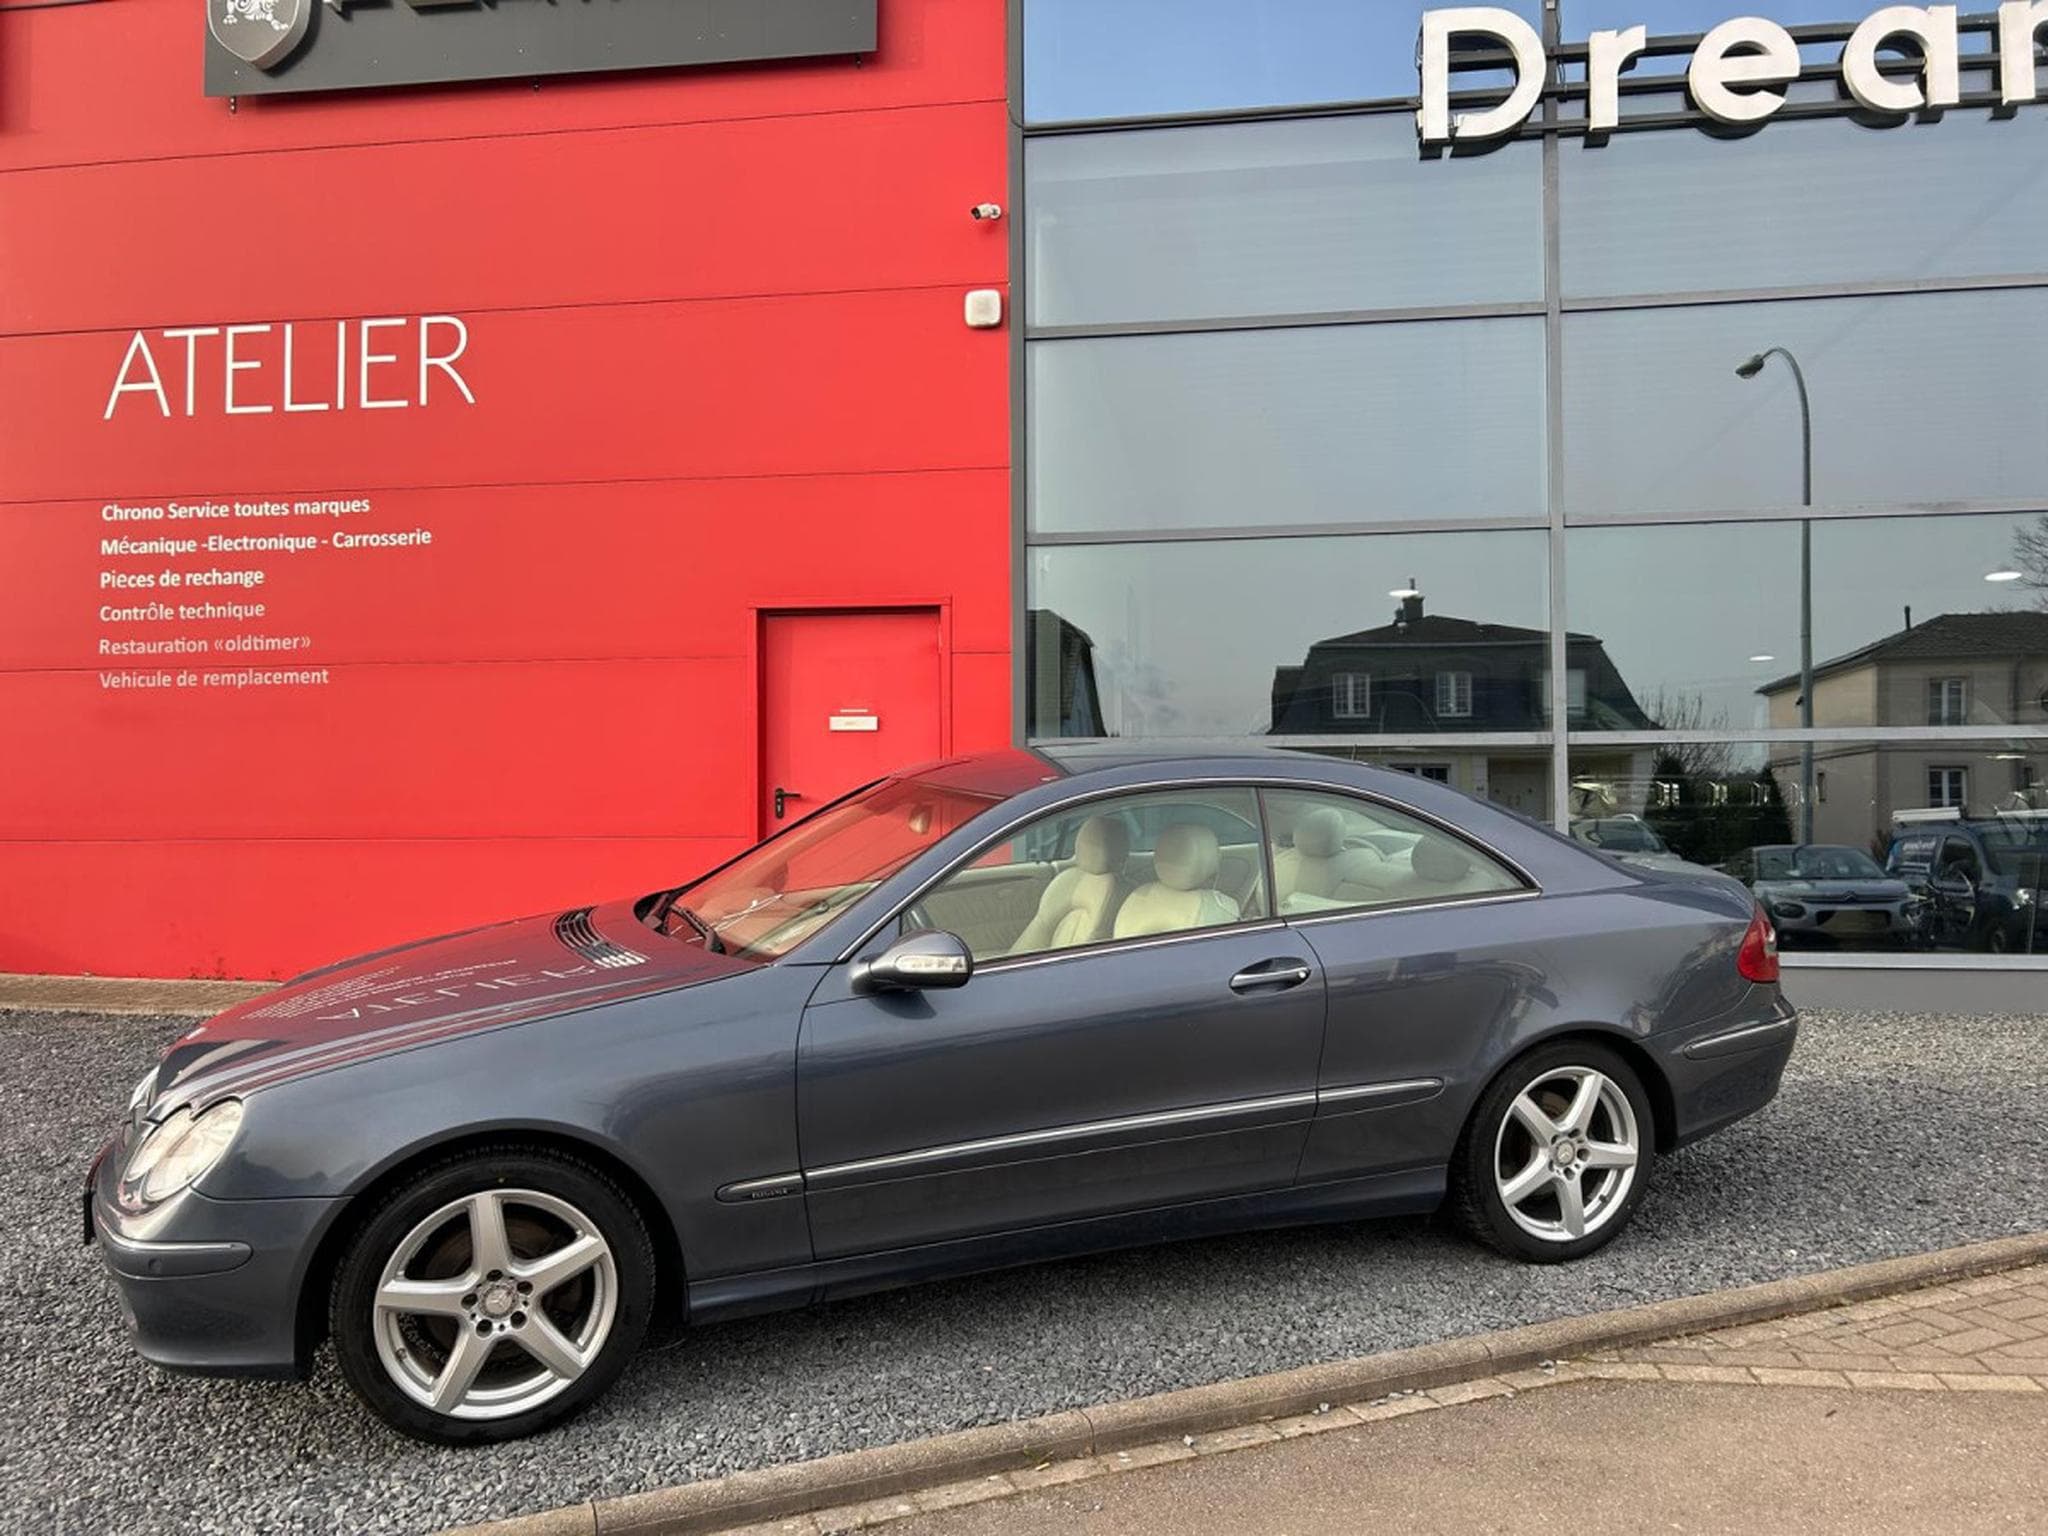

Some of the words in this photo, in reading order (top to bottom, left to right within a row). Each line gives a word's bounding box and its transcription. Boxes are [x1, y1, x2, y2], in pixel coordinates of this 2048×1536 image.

[103, 315, 476, 420] ATELIER
[101, 503, 165, 521] Chrono
[167, 501, 230, 519] Service
[233, 501, 290, 517] toutes
[293, 499, 371, 518] marques
[100, 535, 198, 557] Mécanique
[331, 528, 433, 549] Carrosserie
[100, 570, 156, 588] Pieces
[158, 569, 181, 587] de
[185, 568, 265, 589] rechange
[99, 602, 174, 622] Contrôle
[178, 602, 266, 621] technique
[99, 636, 208, 655] Restauration
[99, 669, 172, 689] Vehicule
[176, 669, 198, 687] de
[203, 668, 329, 688] remplacement
